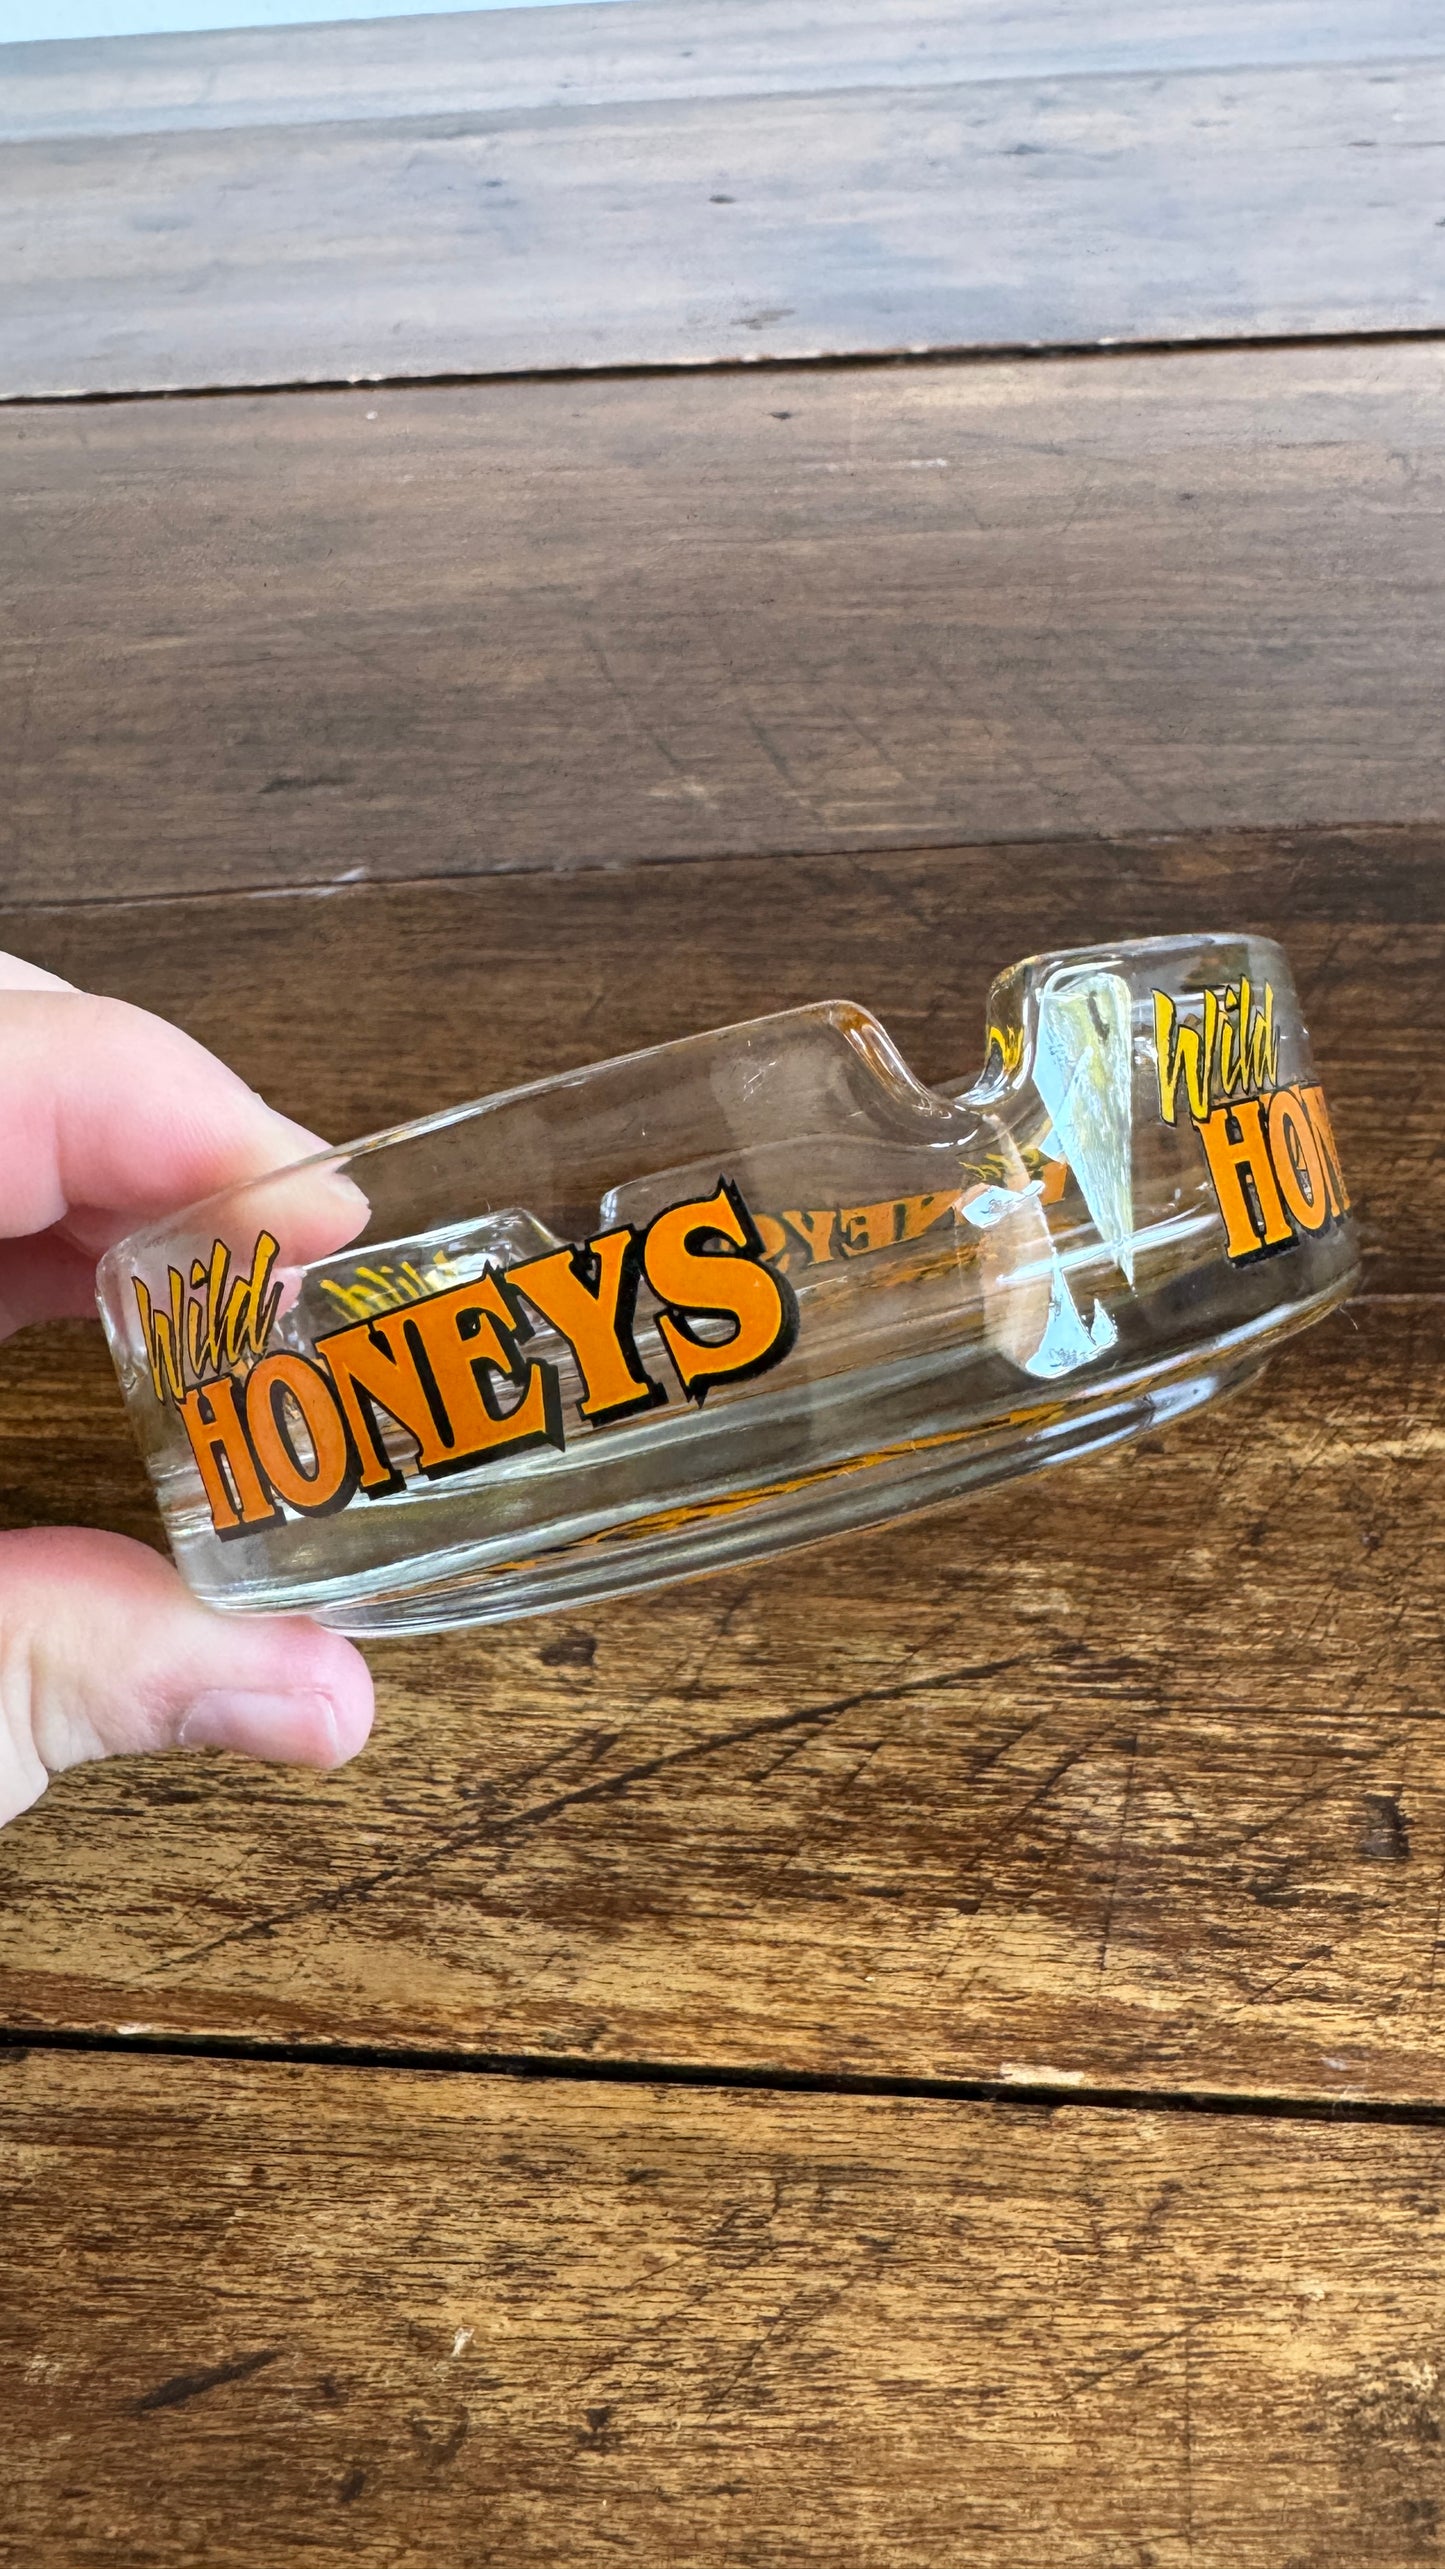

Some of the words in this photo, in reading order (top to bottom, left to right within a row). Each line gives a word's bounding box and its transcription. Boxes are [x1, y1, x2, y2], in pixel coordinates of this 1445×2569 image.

[1152, 974, 1281, 1127] Wild
[131, 1229, 285, 1407] Wild
[175, 1172, 800, 1541] HONEYS
